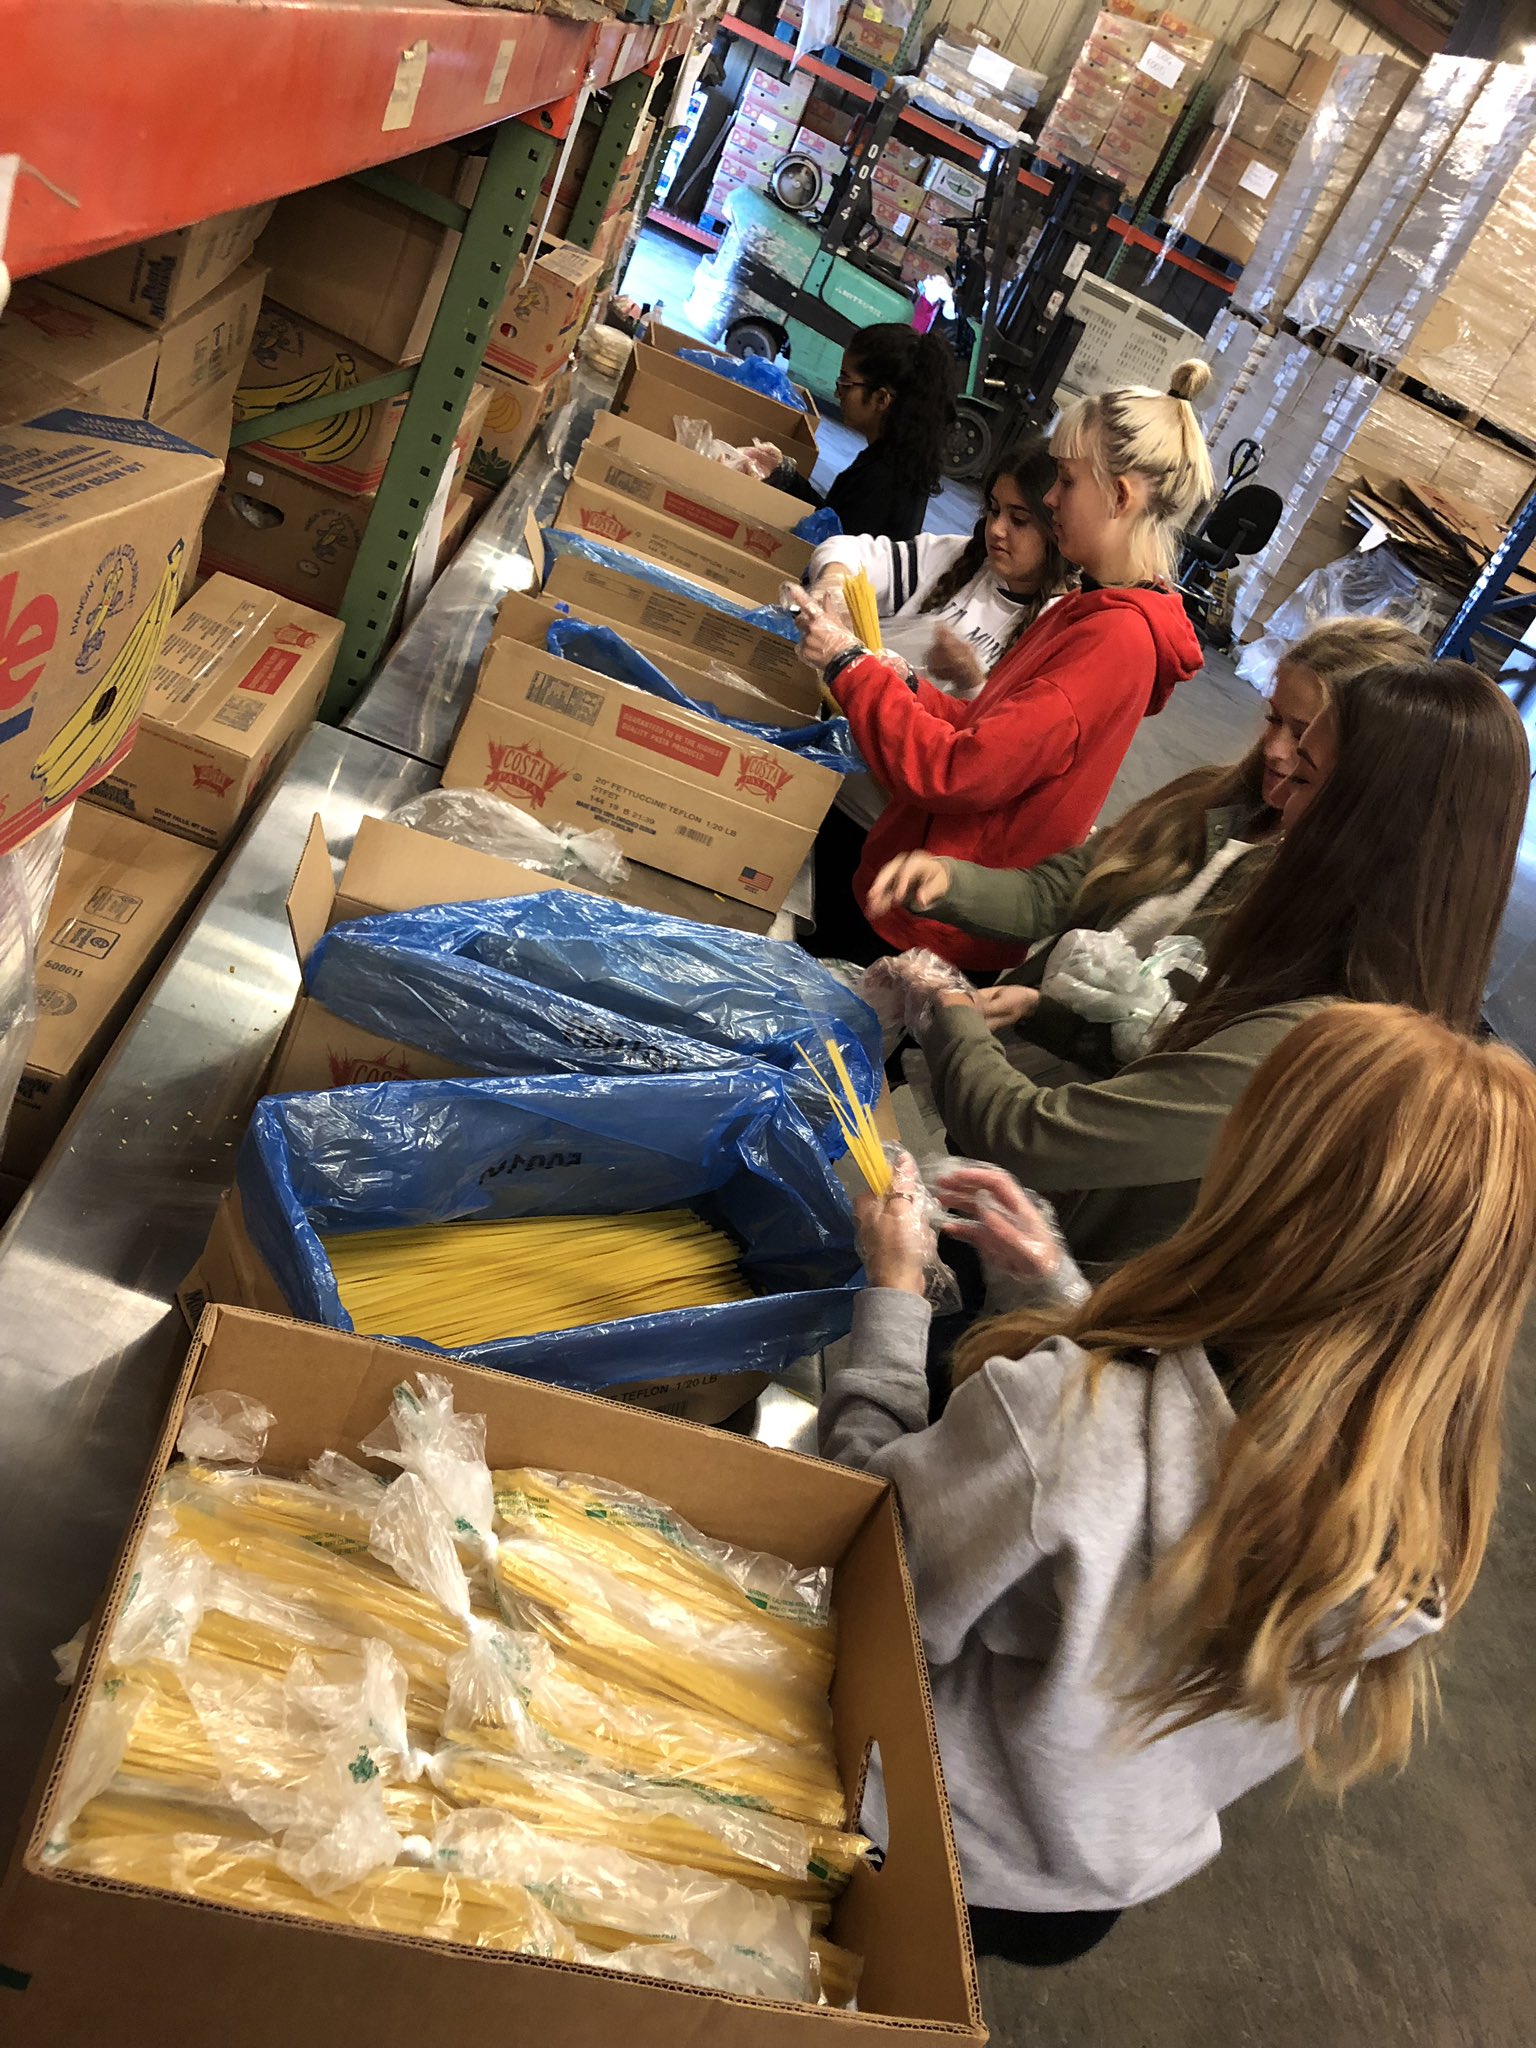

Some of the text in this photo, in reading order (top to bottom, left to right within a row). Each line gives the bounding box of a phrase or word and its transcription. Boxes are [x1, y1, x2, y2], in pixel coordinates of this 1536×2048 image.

[754, 72, 780, 96] Dole
[733, 130, 758, 152] Dole
[800, 129, 825, 151] Dole
[722, 159, 747, 180] Dole
[503, 749, 546, 782] COSTA
[749, 758, 780, 783] COSTA
[499, 774, 537, 796] PASTA
[611, 782, 668, 810] FETTUCCINE
[669, 805, 703, 824] TEFLON
[725, 827, 737, 837] LB
[44, 960, 84, 978] 500611
[621, 1384, 670, 1402] TEFLON
[702, 1373, 718, 1385] LB
